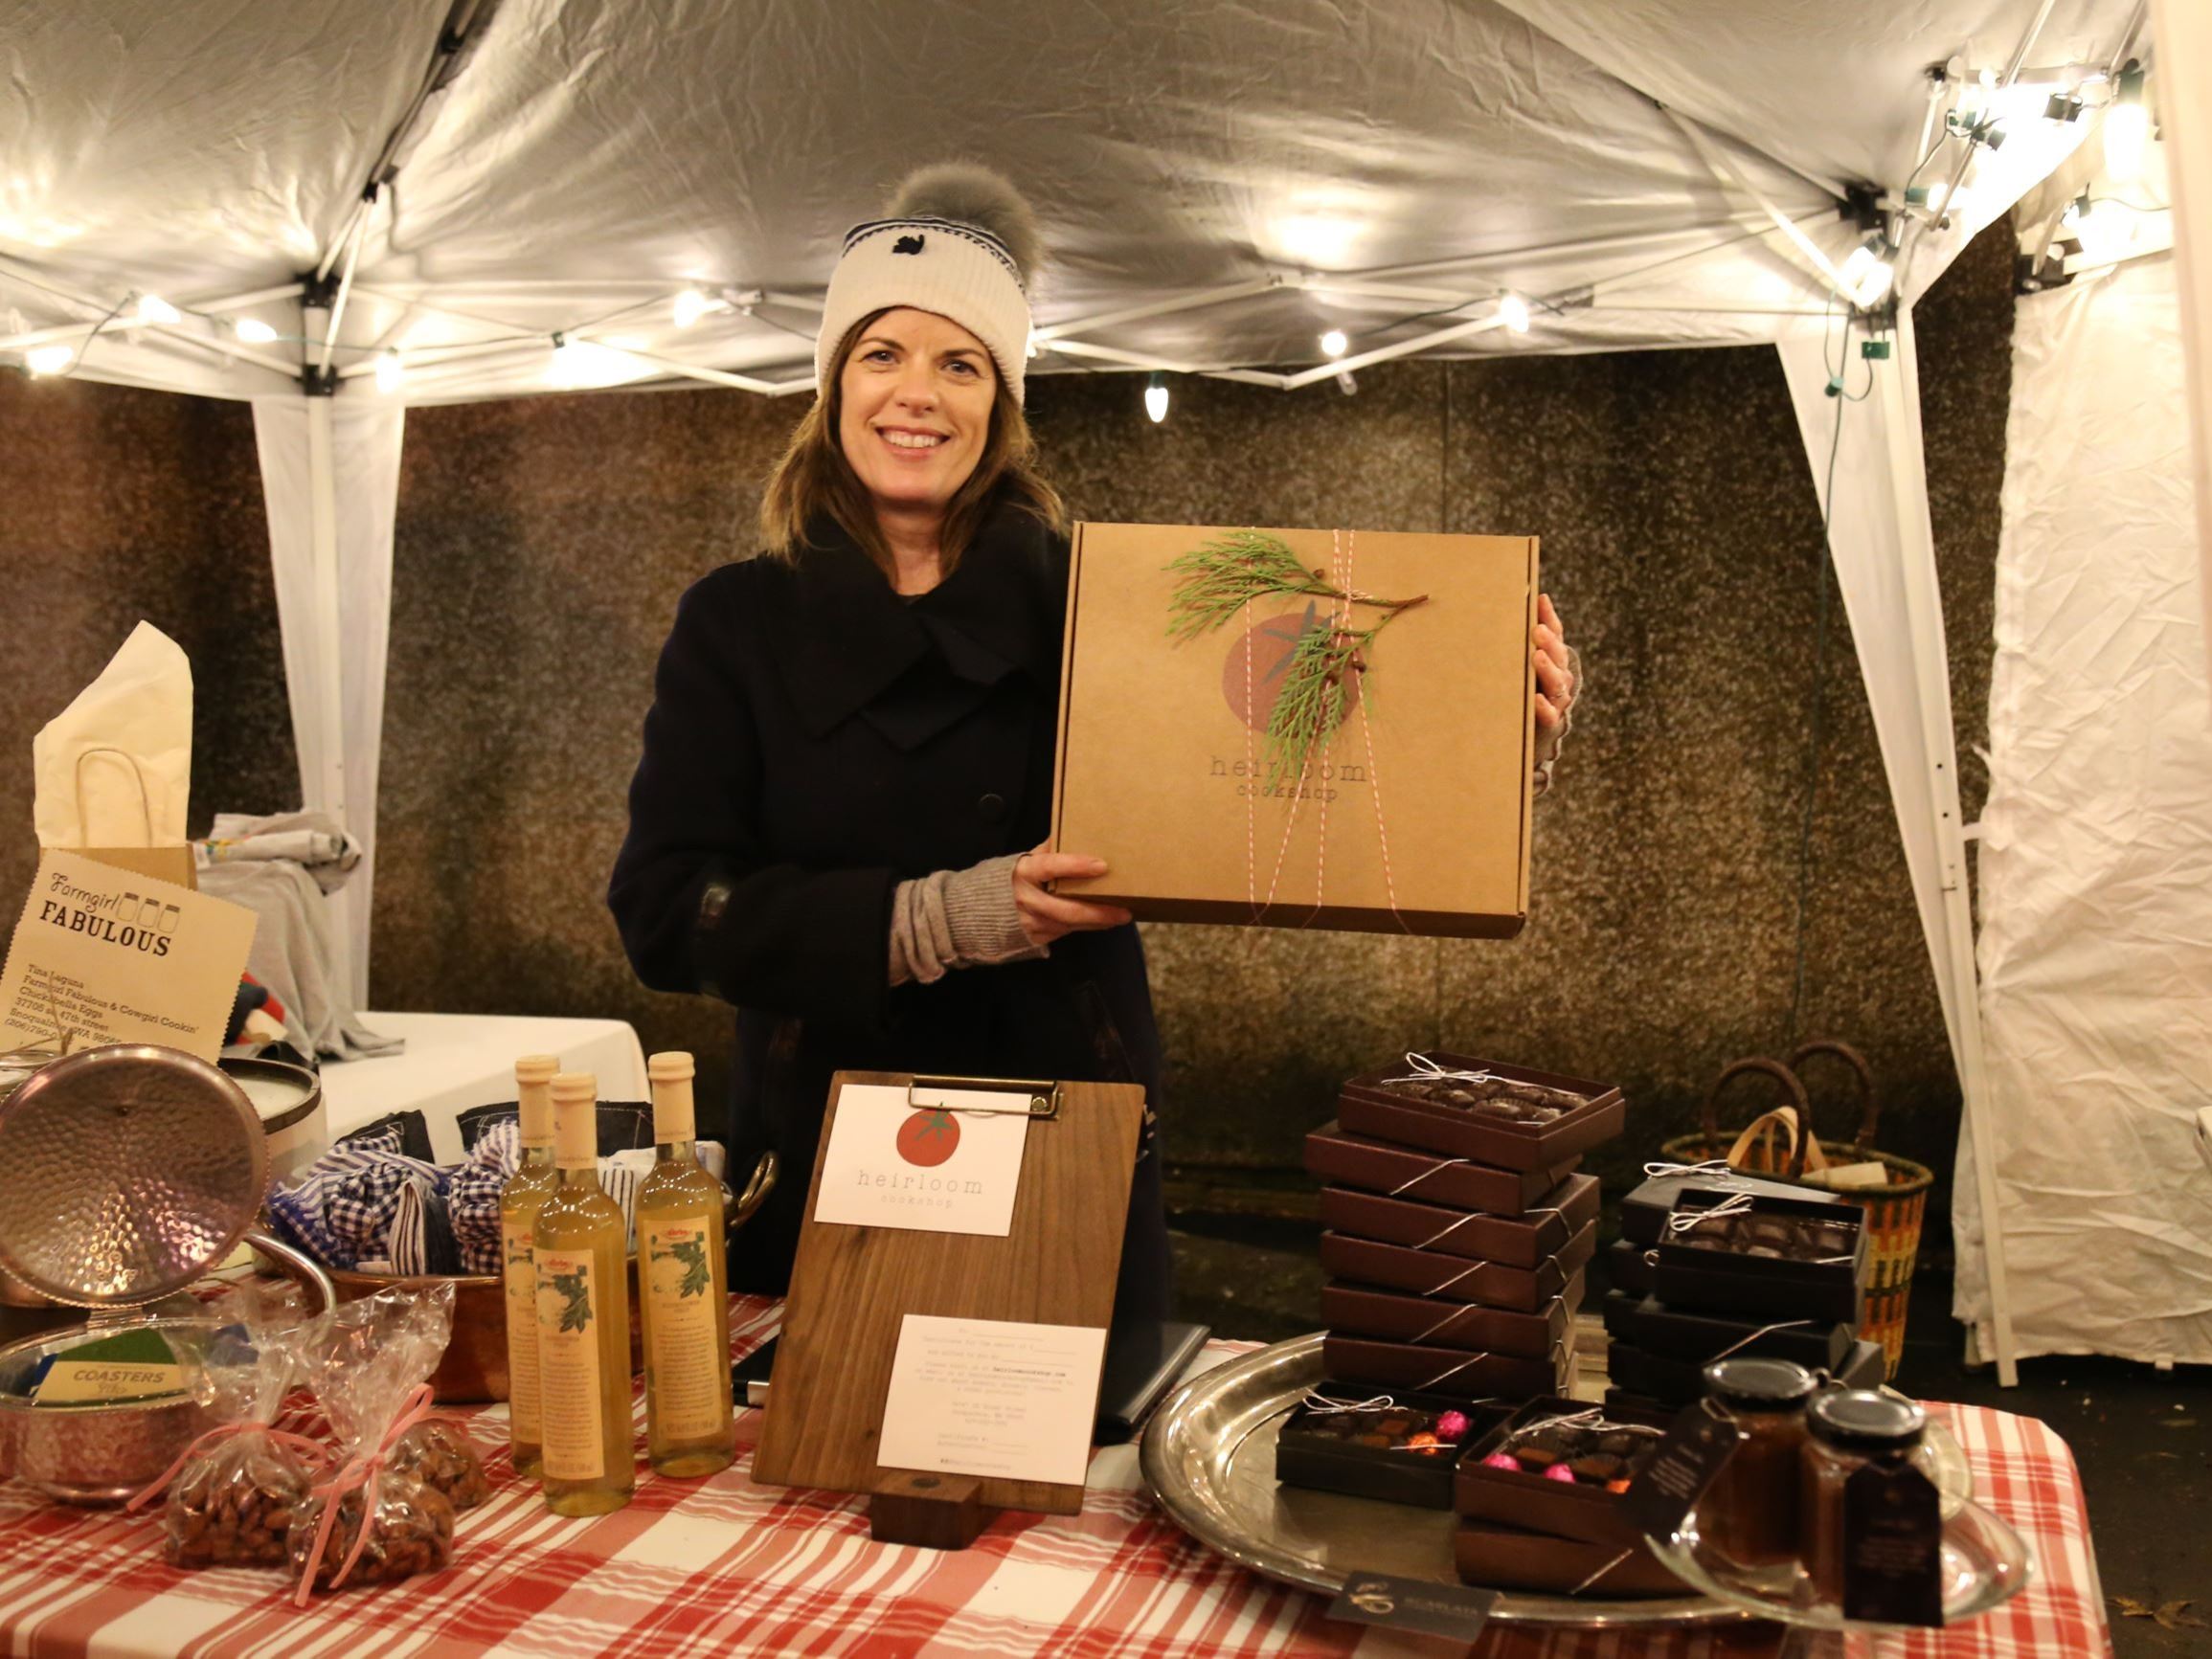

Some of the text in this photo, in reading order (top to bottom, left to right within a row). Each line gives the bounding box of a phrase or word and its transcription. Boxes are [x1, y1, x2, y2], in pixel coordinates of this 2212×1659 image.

[1236, 783, 1339, 803] cookshop
[51, 872, 121, 913] Farmgirl
[39, 900, 171, 956] FABULOUS
[23, 975, 65, 996] Farmirl
[65, 988, 108, 1008] Fabulous
[109, 1002, 118, 1011] &
[119, 1004, 158, 1023] Cowgirl
[79, 1004, 102, 1019] Eggs
[81, 1019, 109, 1032] street
[857, 1170, 982, 1196] heirloom
[73, 1369, 166, 1383] COASTERS
